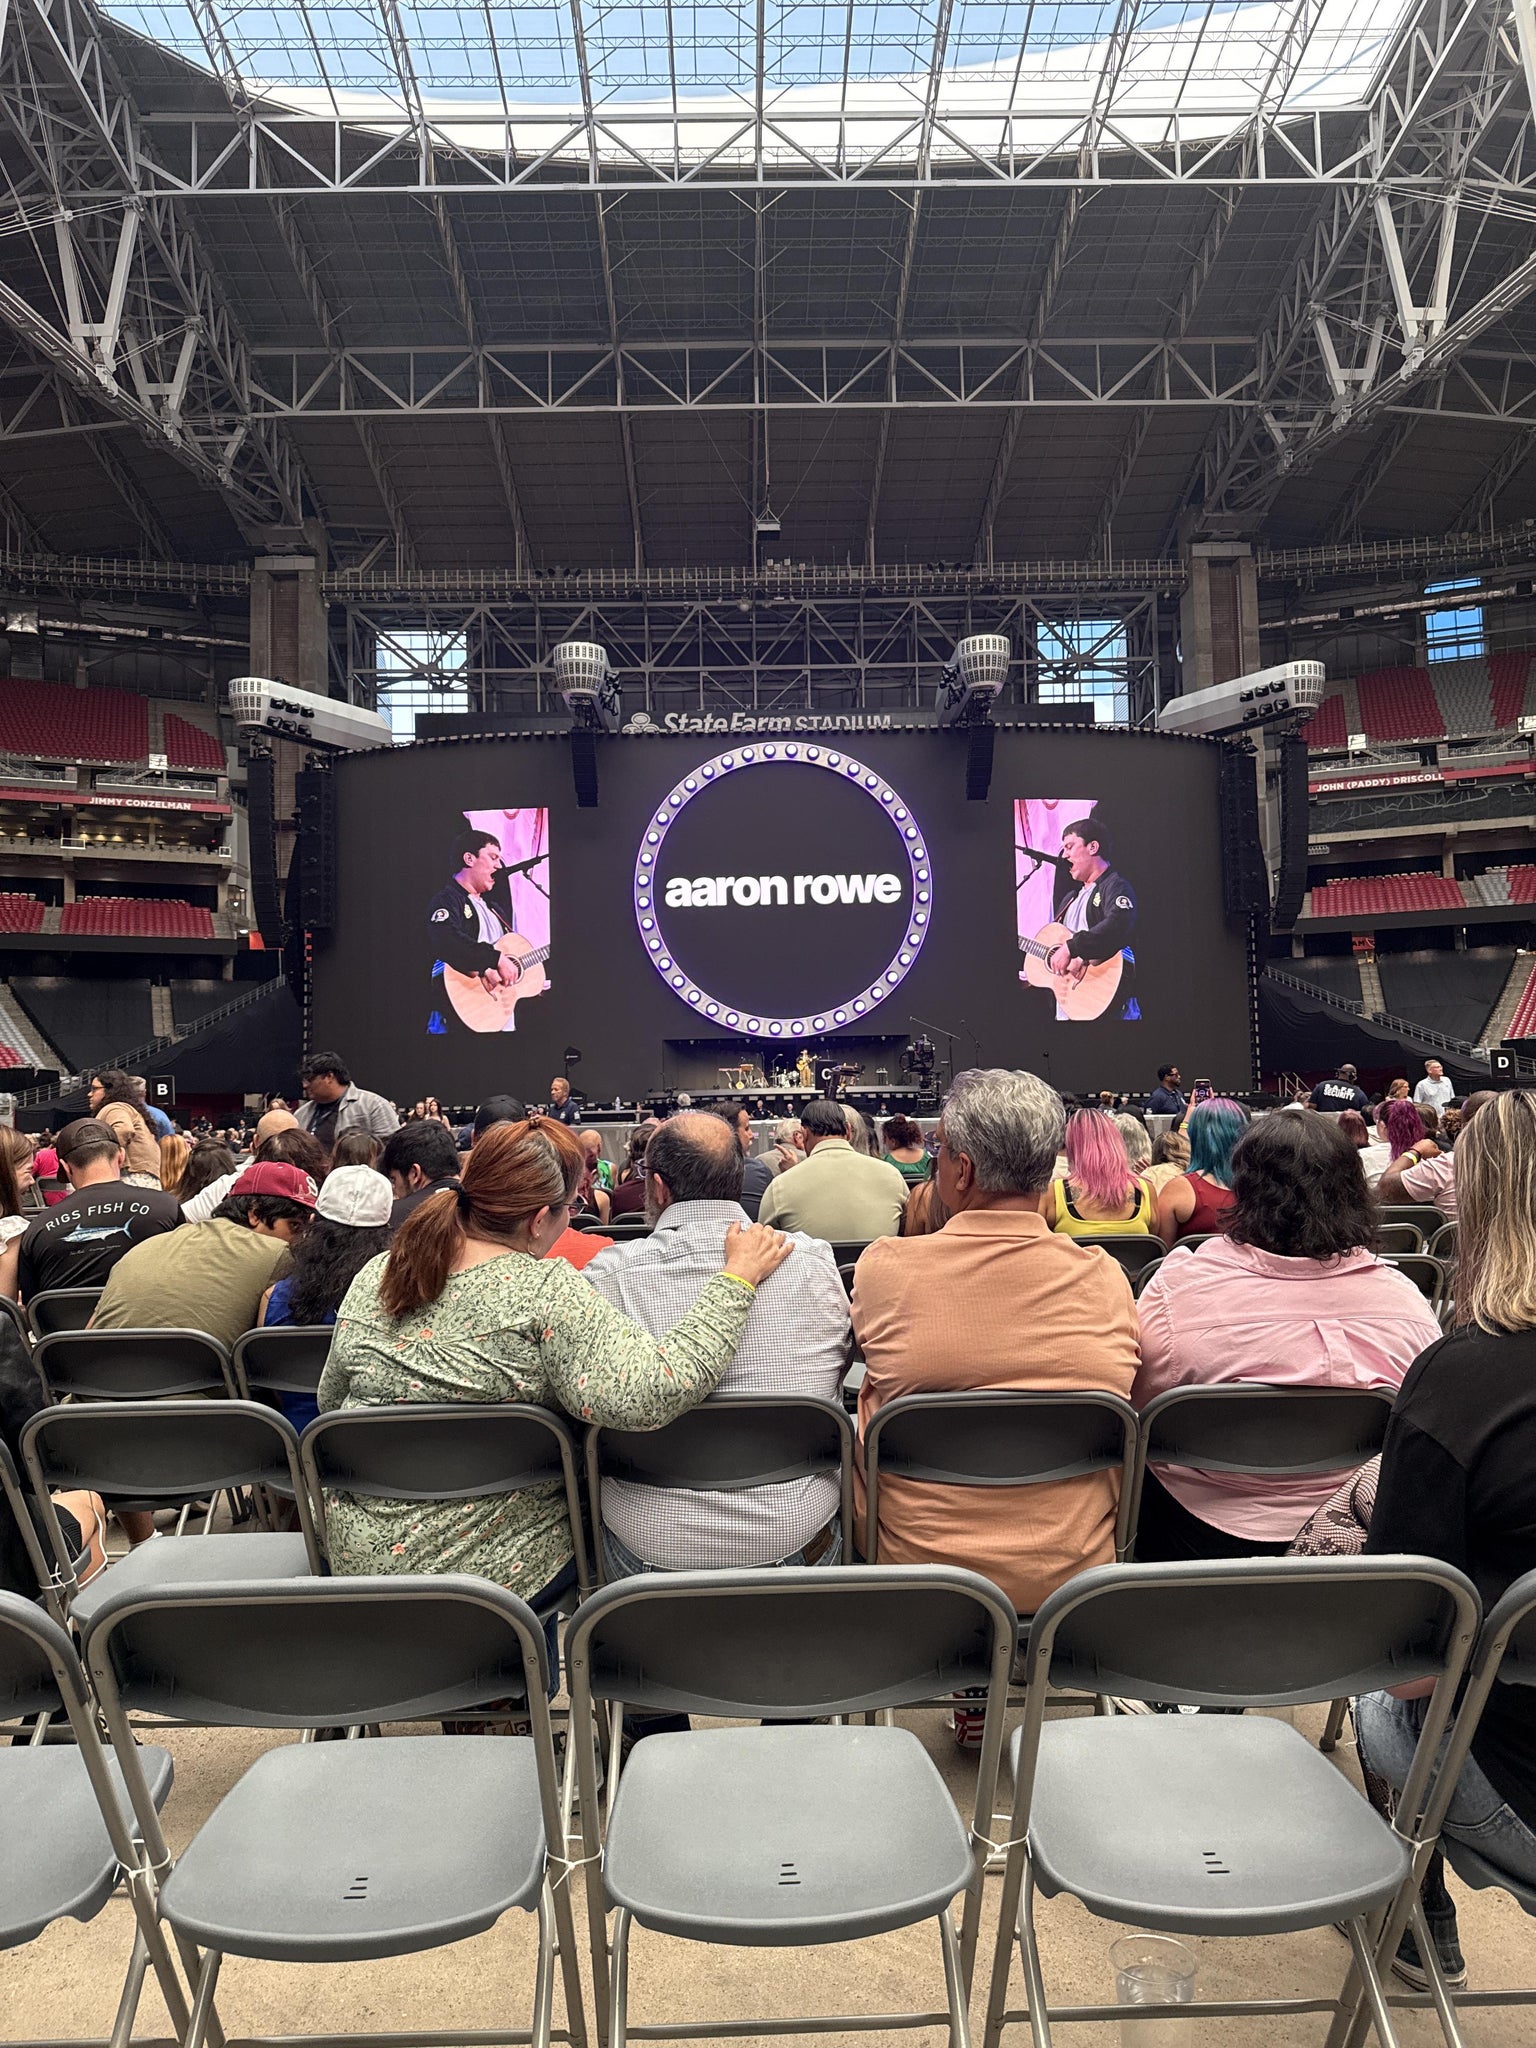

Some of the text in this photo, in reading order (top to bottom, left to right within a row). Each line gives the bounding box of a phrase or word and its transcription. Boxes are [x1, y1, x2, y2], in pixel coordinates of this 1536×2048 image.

[796, 715, 891, 731] STADIUM
[1317, 773, 1445, 792] JOHN (PADDY) DRISCOLL
[89, 797, 192, 811] JIMMY CONZELMAN
[665, 873, 902, 908] aaron rowe
[1497, 1056, 1510, 1069] D
[157, 1083, 169, 1096] B
[1323, 1087, 1356, 1101] SECURITY
[45, 1201, 150, 1232] RIGS FISH CO
